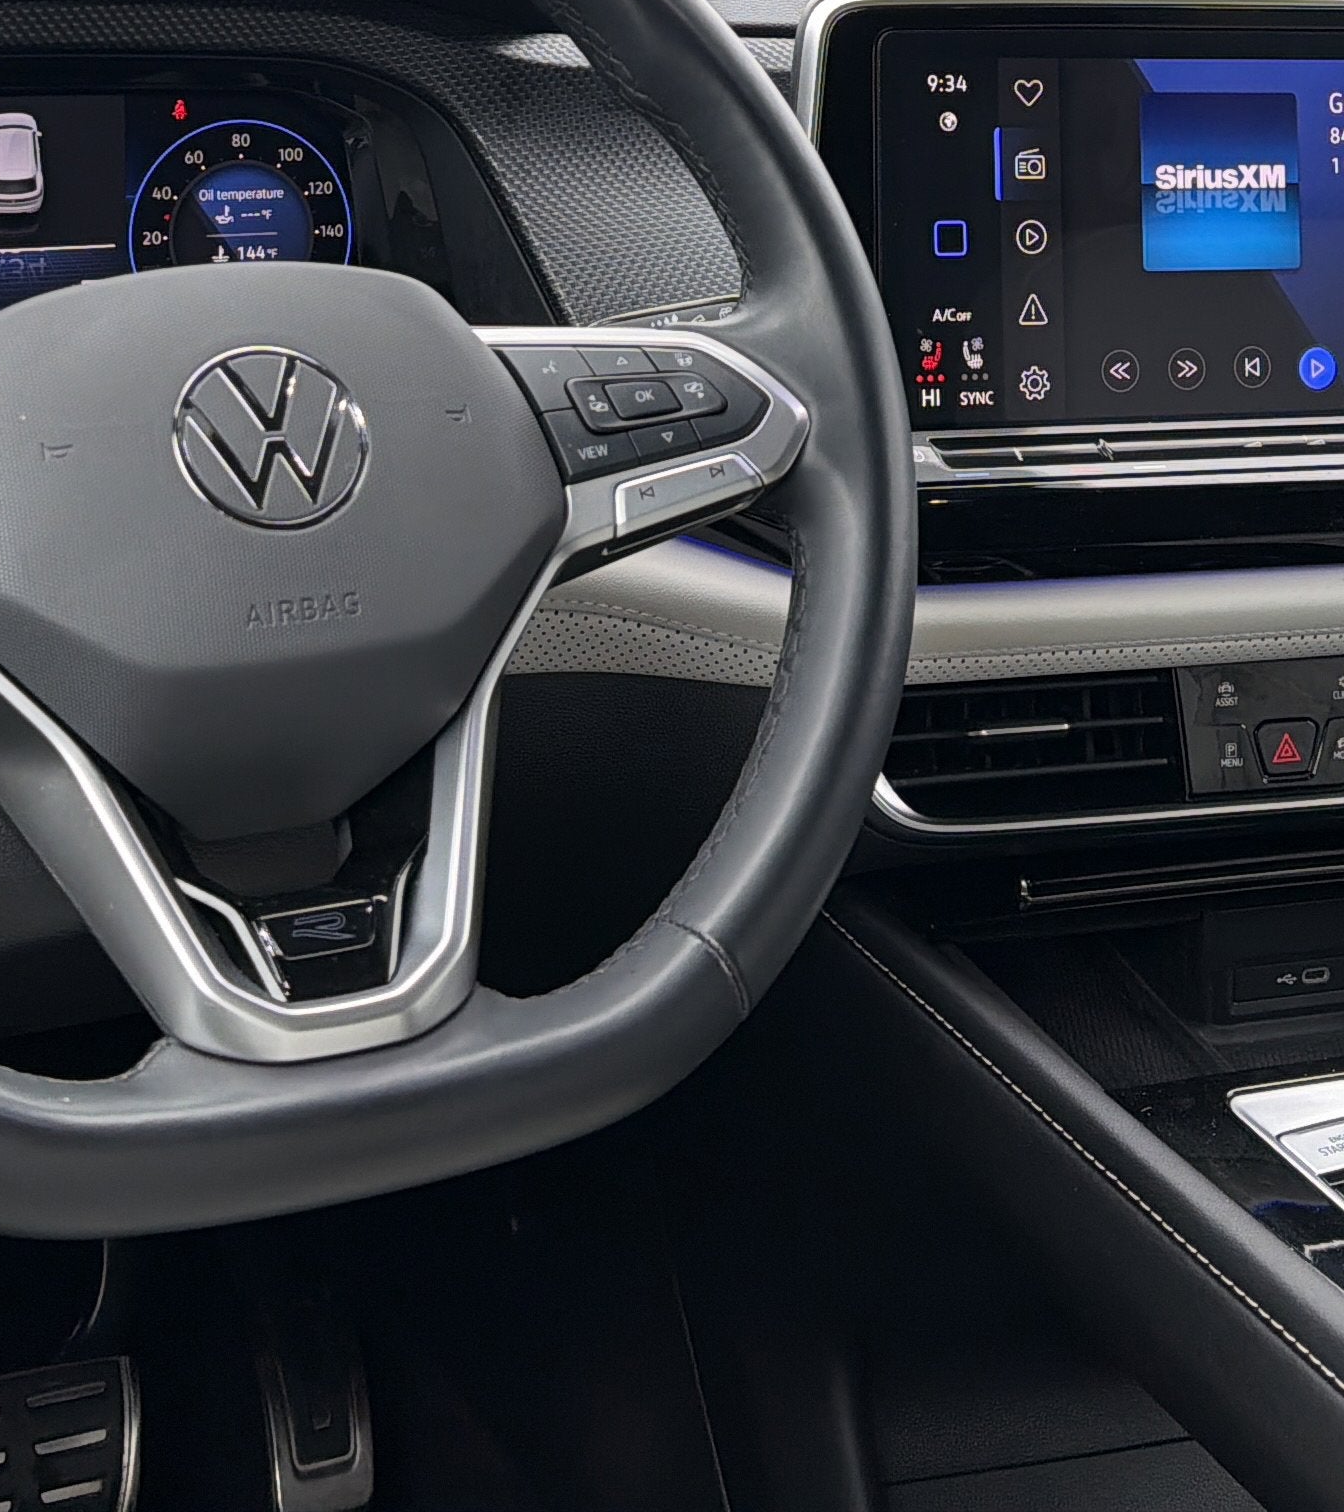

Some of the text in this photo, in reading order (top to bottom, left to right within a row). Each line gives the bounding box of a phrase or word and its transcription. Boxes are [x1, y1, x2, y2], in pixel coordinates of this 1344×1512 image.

[927, 74, 968, 93] 9:34
[231, 133, 251, 148] 80
[184, 150, 204, 165] 60
[278, 148, 303, 162] 100
[1331, 157, 1340, 174] 1
[1155, 164, 1286, 190] SiriusXM
[152, 187, 172, 201] 40
[198, 188, 284, 203] Oil temperature
[308, 181, 333, 195] 120
[142, 231, 162, 246] 20
[319, 224, 344, 238] 140
[635, 390, 655, 403] OK
[921, 388, 941, 407] HI
[959, 390, 994, 406] SYNC
[577, 444, 609, 461] VIEW
[247, 591, 362, 629] AIRBAG
[1215, 697, 1239, 707] ASSIST
[1220, 758, 1244, 768] MENU
